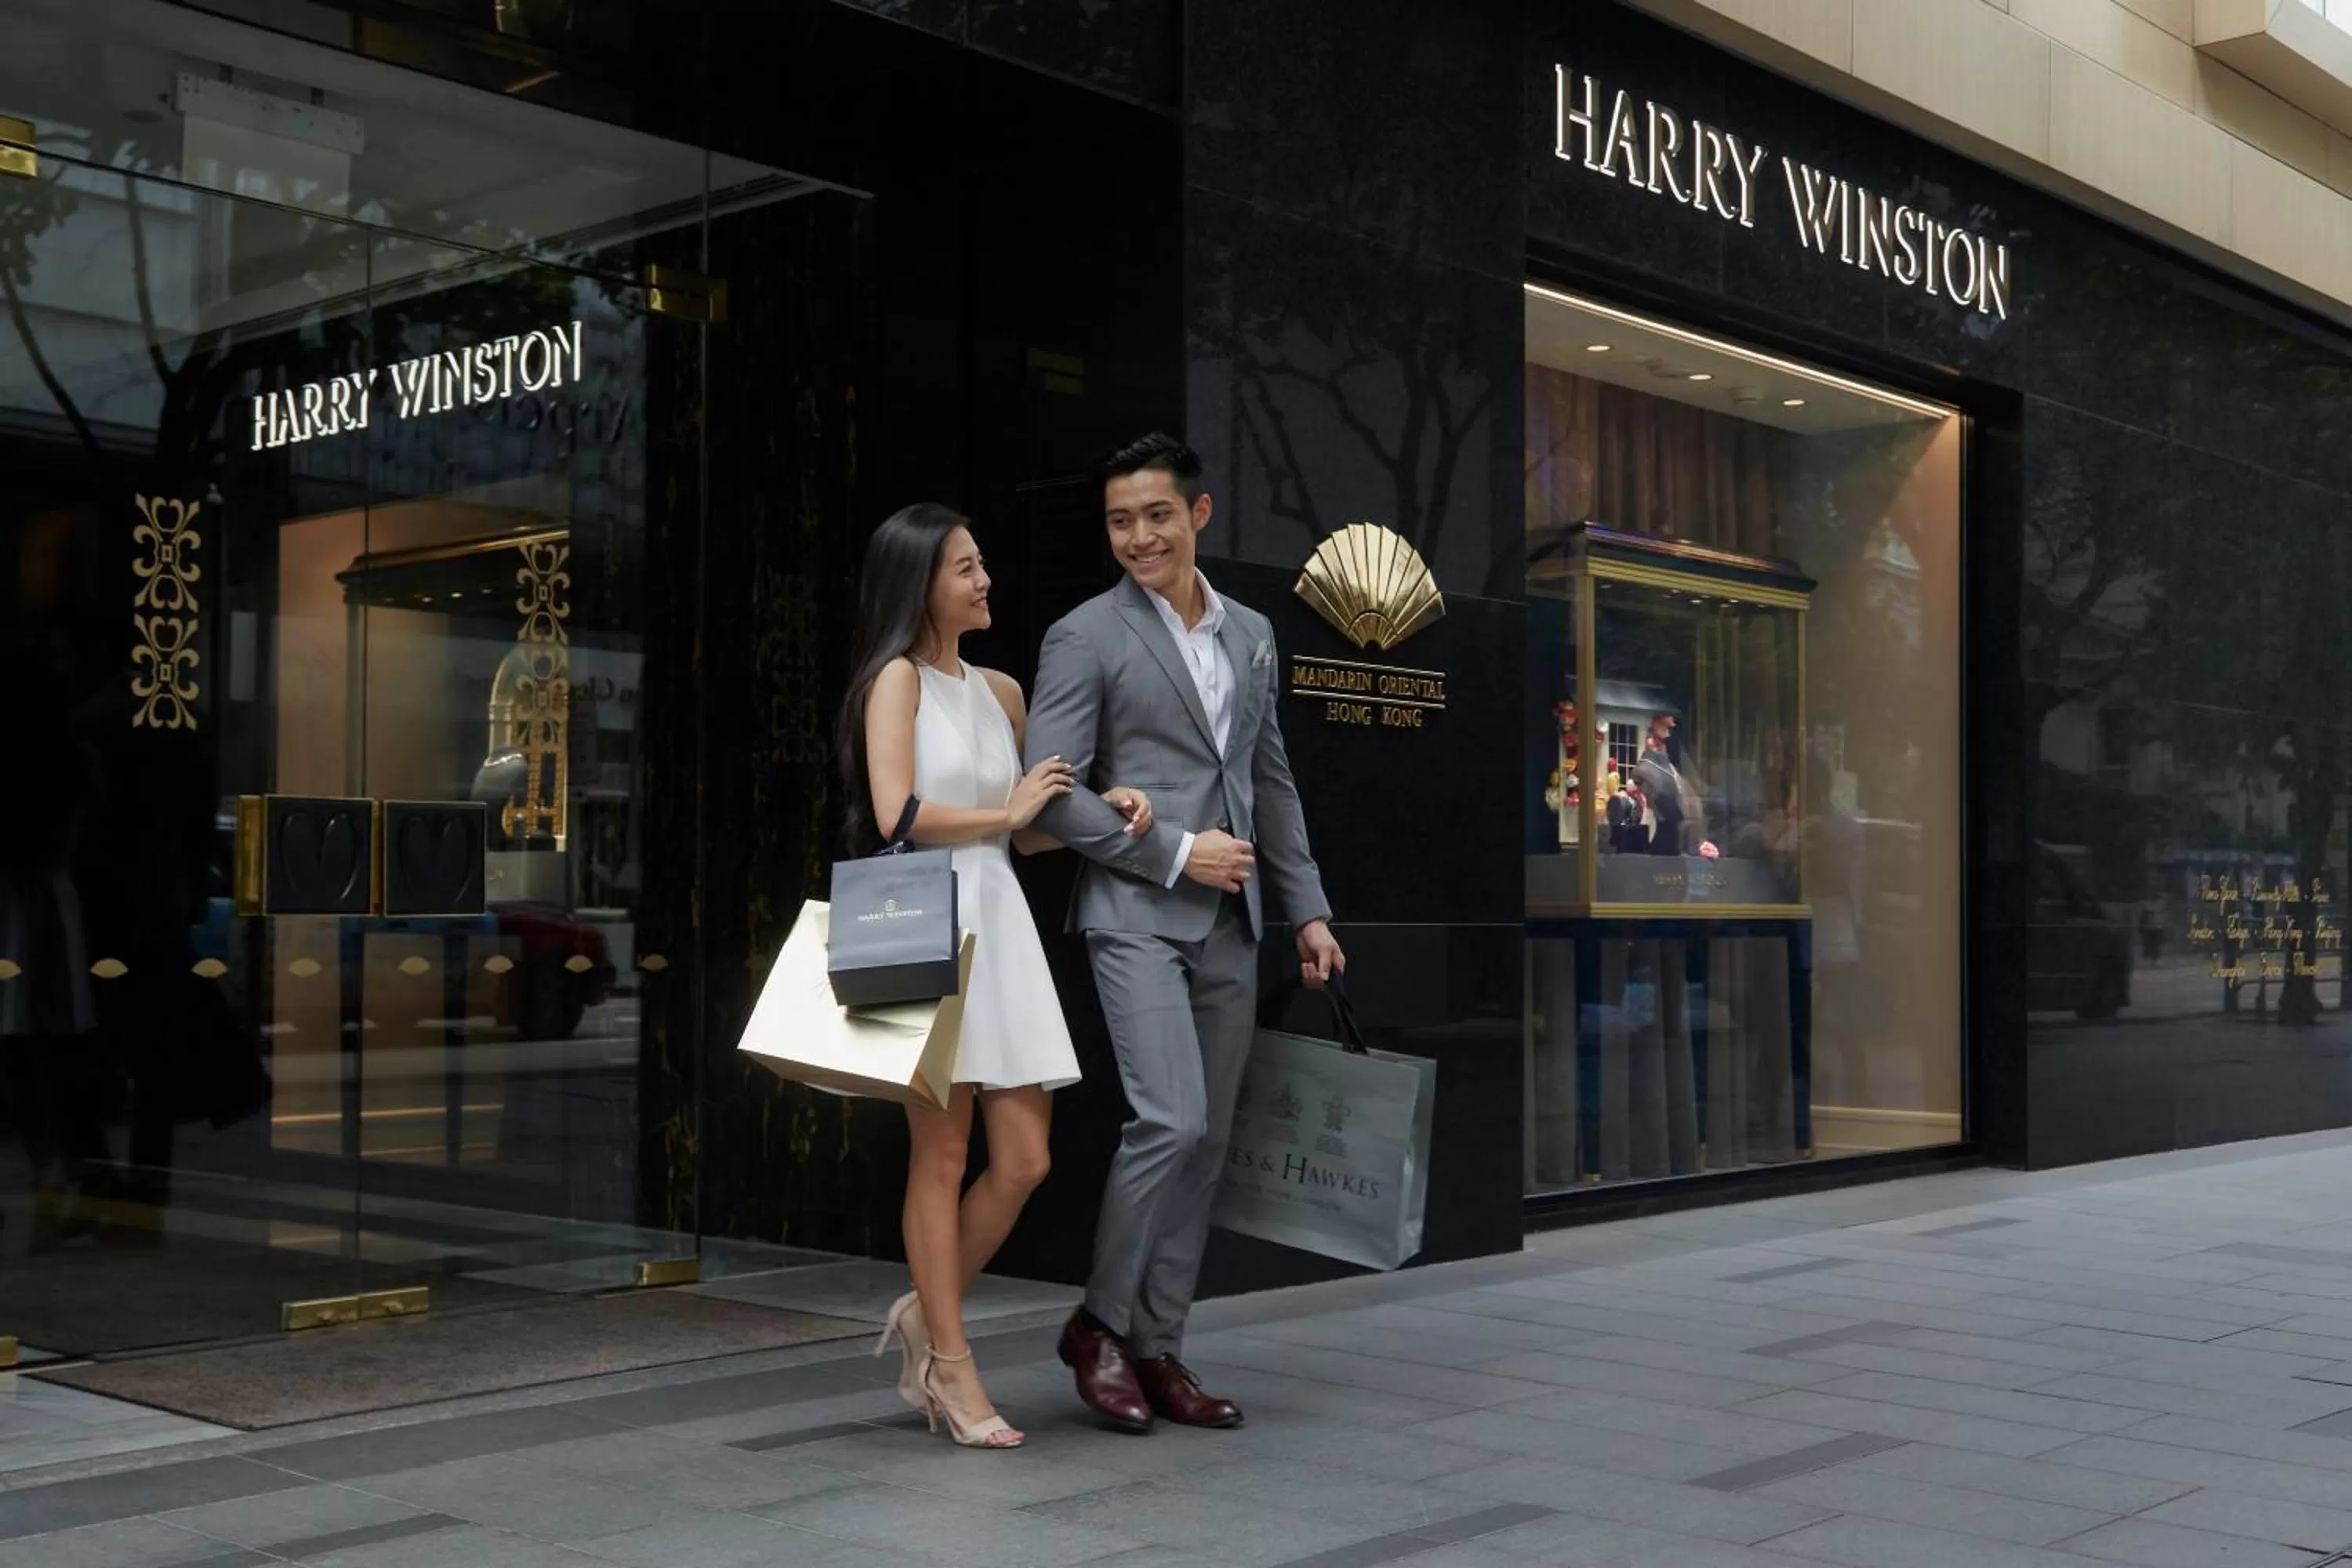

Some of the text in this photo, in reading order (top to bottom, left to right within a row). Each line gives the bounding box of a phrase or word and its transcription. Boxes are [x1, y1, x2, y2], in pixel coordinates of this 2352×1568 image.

[1555, 64, 2009, 320] HARRY WINSTON
[250, 321, 583, 452] HARRY WINSTON
[1291, 666, 1446, 700] MANDARIN ORIENTAL
[1325, 702, 1424, 728] HONG KONG
